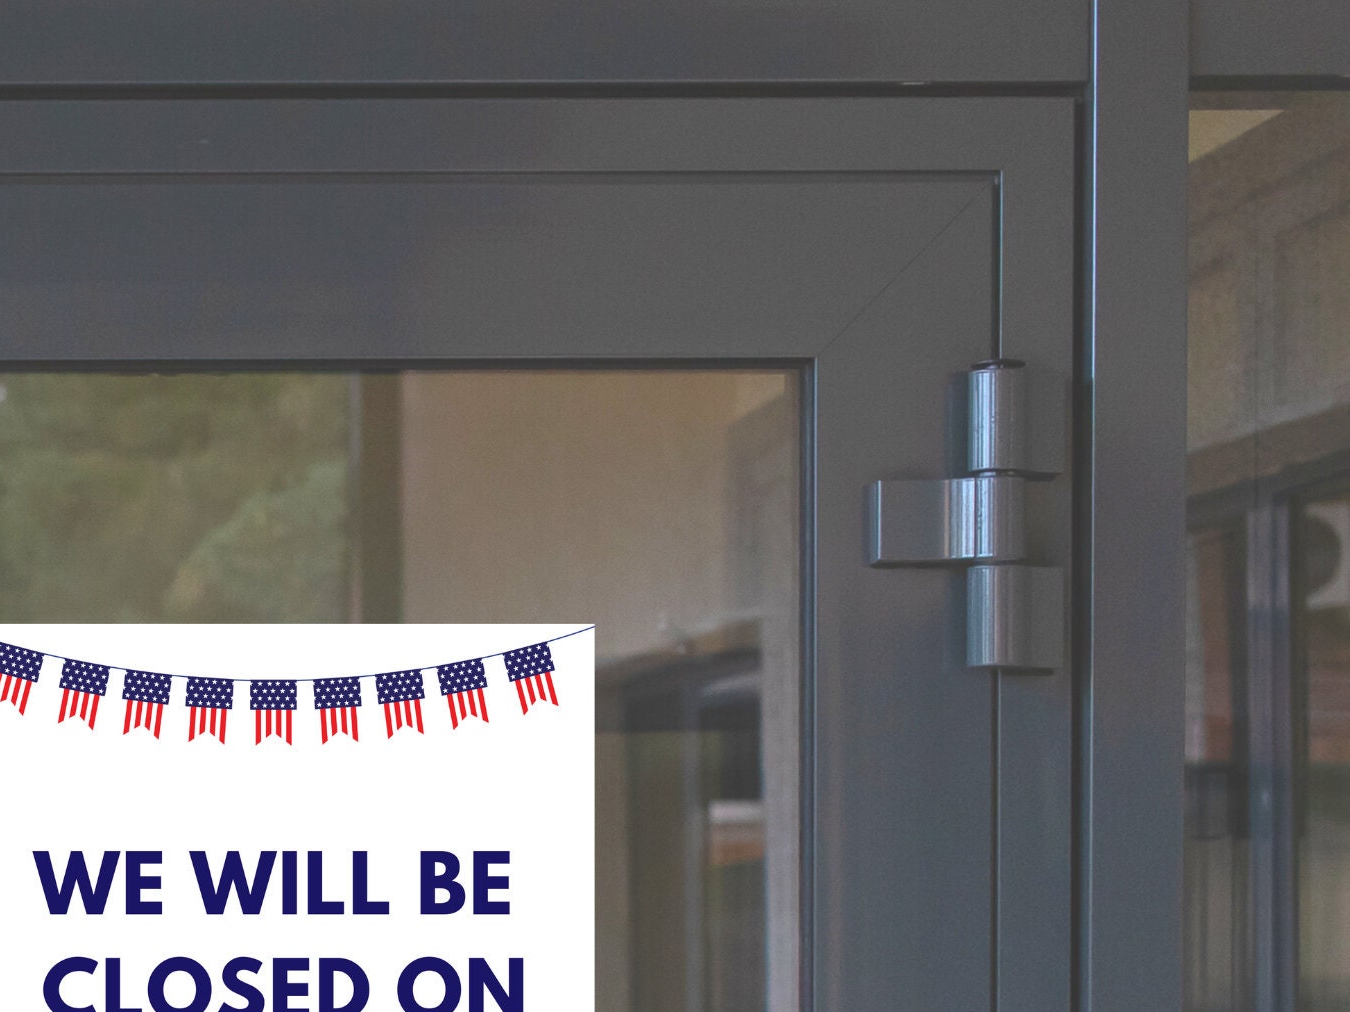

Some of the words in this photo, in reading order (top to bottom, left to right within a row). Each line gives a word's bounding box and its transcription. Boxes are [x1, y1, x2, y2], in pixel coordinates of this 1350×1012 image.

[32, 850, 163, 915] WE
[188, 850, 390, 915] WILL
[420, 850, 511, 915] BE
